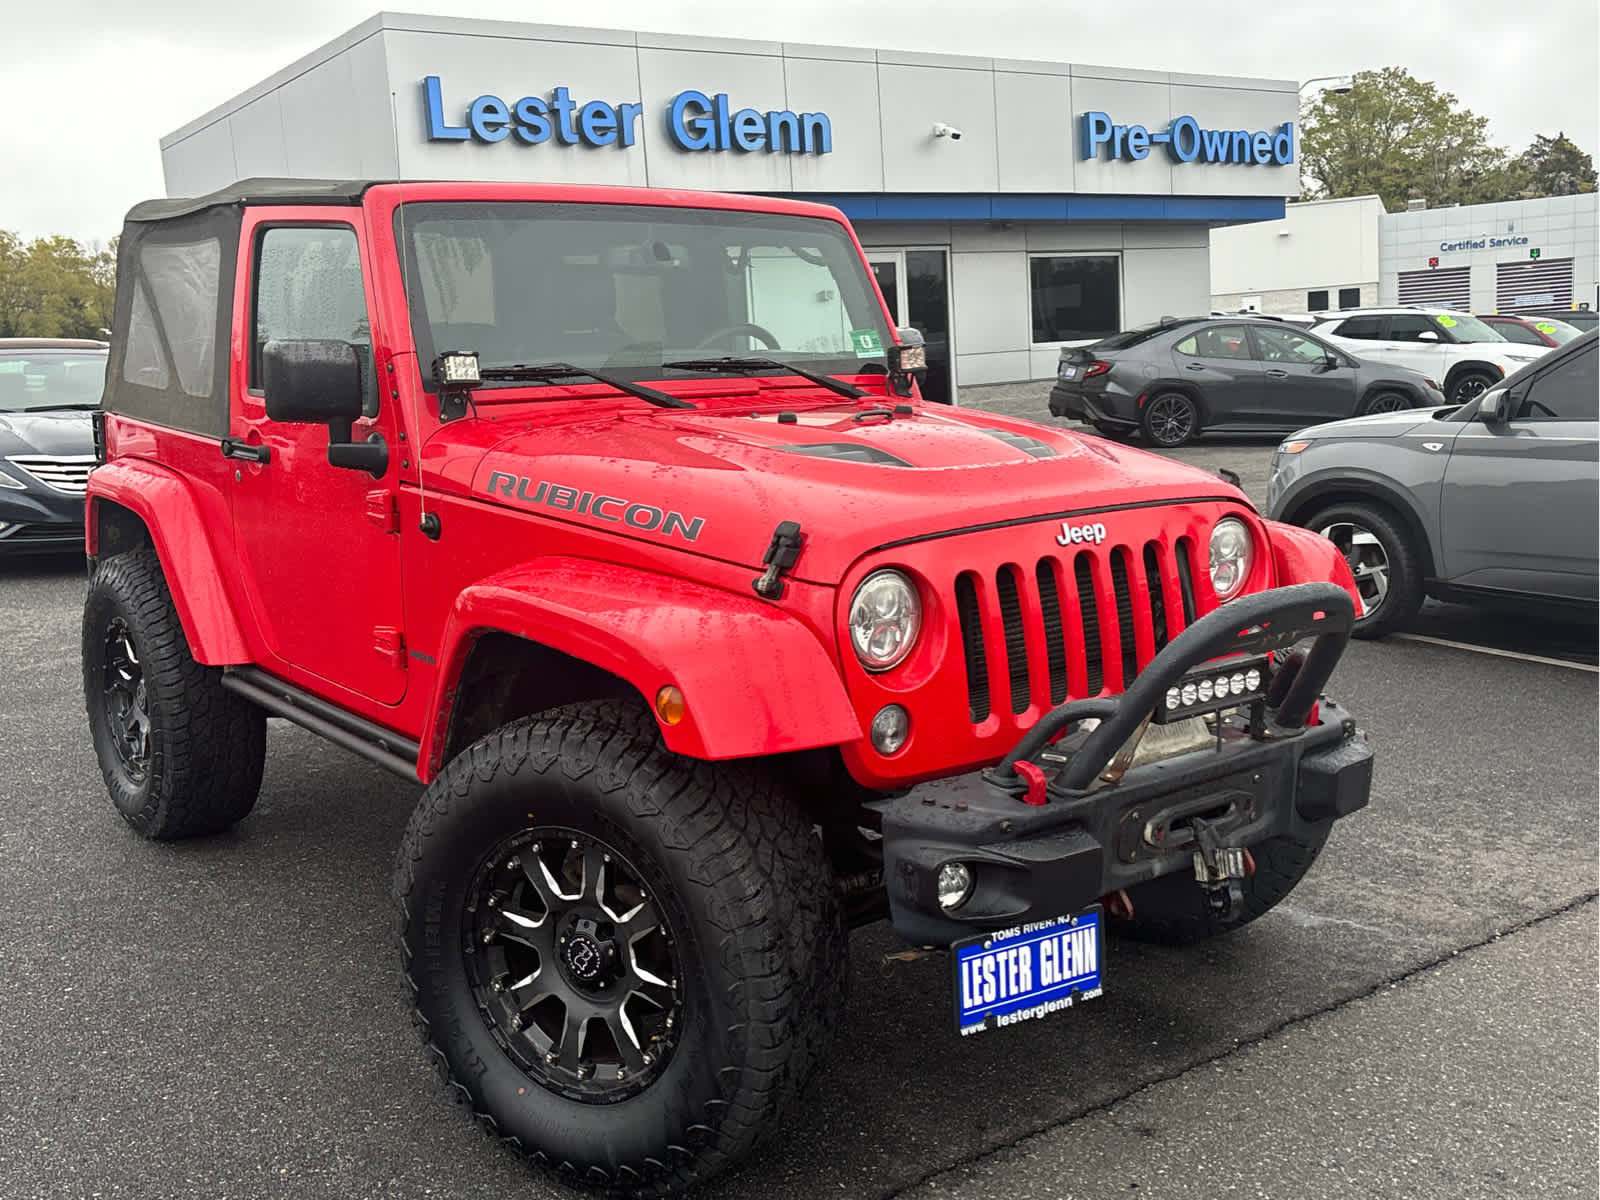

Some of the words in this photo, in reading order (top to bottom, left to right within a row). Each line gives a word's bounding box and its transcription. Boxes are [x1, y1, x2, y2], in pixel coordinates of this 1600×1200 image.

[423, 75, 642, 147] Lester
[666, 90, 832, 155] Glenn
[1080, 111, 1294, 165] Pre-Owned
[1440, 239, 1485, 252] Certified
[1489, 236, 1528, 248] Service
[487, 470, 705, 542] RUBICON
[1056, 522, 1106, 546] Jeep
[991, 926, 1021, 943] TOMS
[1057, 914, 1070, 926] NJ
[962, 945, 1032, 1010] LESTER
[1040, 927, 1097, 987] GLENN
[960, 1022, 987, 1037] www.
[996, 995, 1073, 1028] lesterglenn
[1081, 986, 1103, 1001] .com
